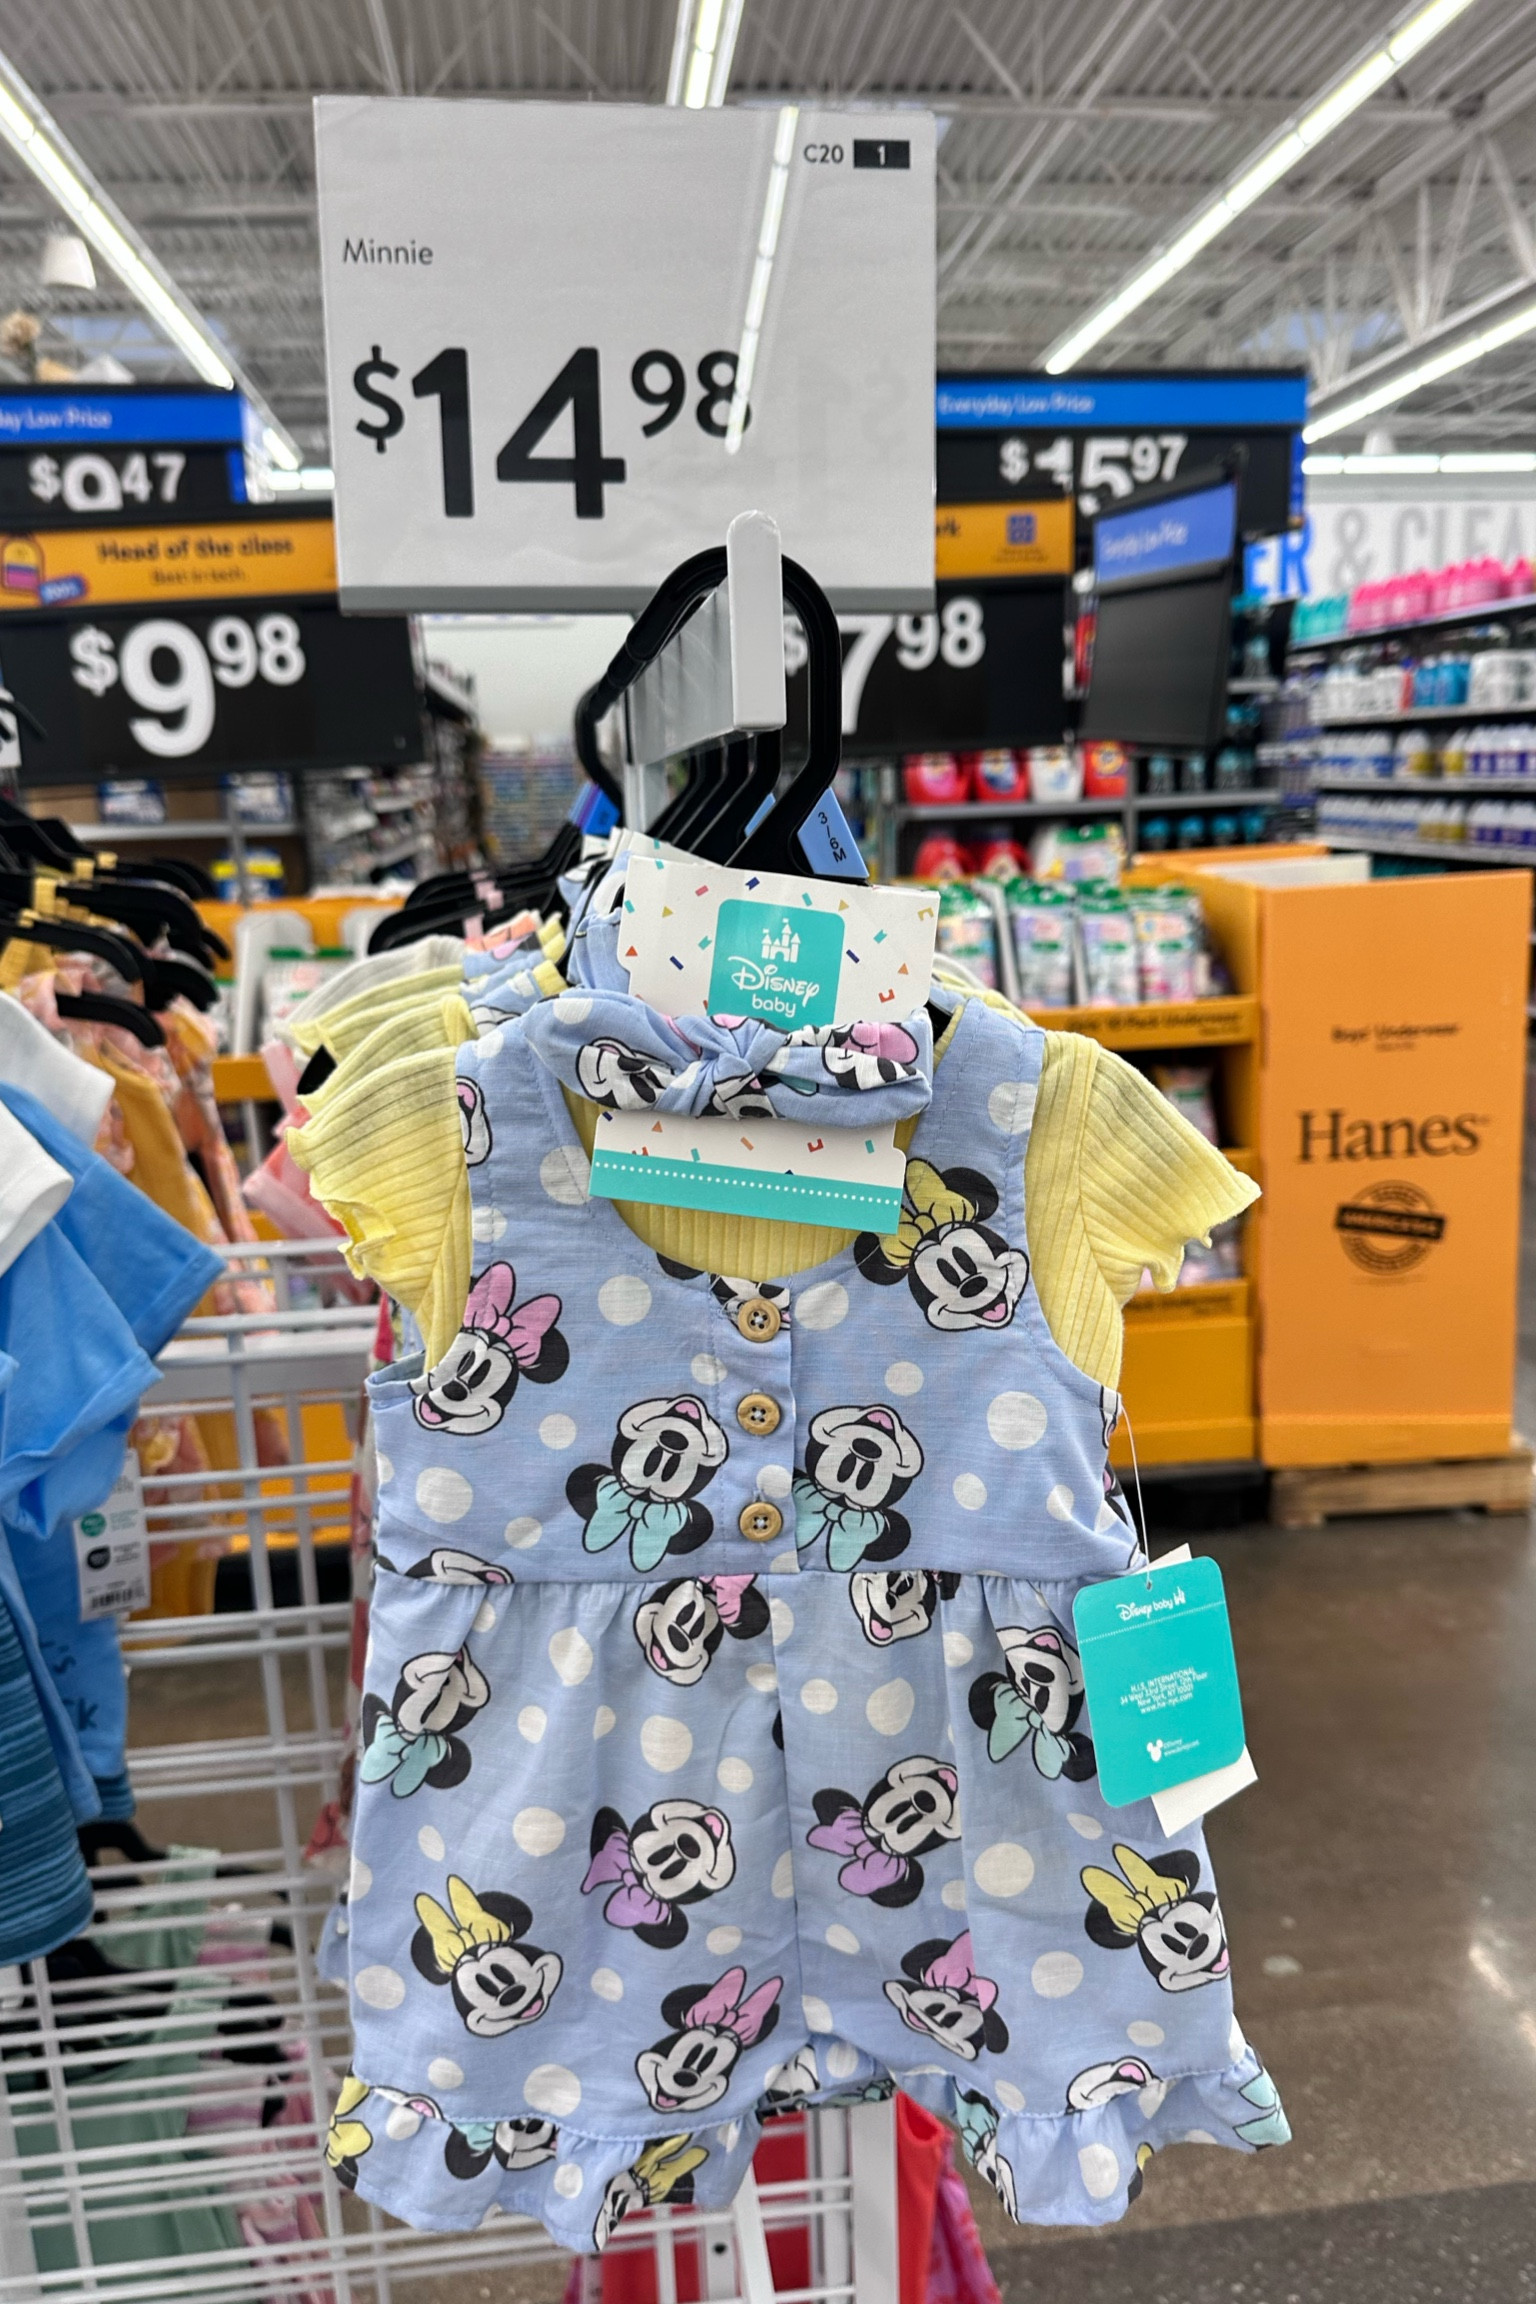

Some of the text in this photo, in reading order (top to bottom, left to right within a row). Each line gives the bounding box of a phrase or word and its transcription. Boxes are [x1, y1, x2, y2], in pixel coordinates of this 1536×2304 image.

[803, 144, 886, 166] C20 1
[342, 237, 434, 266] Minnie
[25, 407, 63, 429] Low
[65, 405, 113, 429] Price
[98, 535, 294, 562] Head of the class
[728, 955, 820, 1008] Disney
[752, 993, 796, 1018] baby
[1297, 1108, 1482, 1165] Hanes
[1115, 1598, 1174, 1621] Disney baby
[1147, 1666, 1195, 1687] INTERNATIONAL
